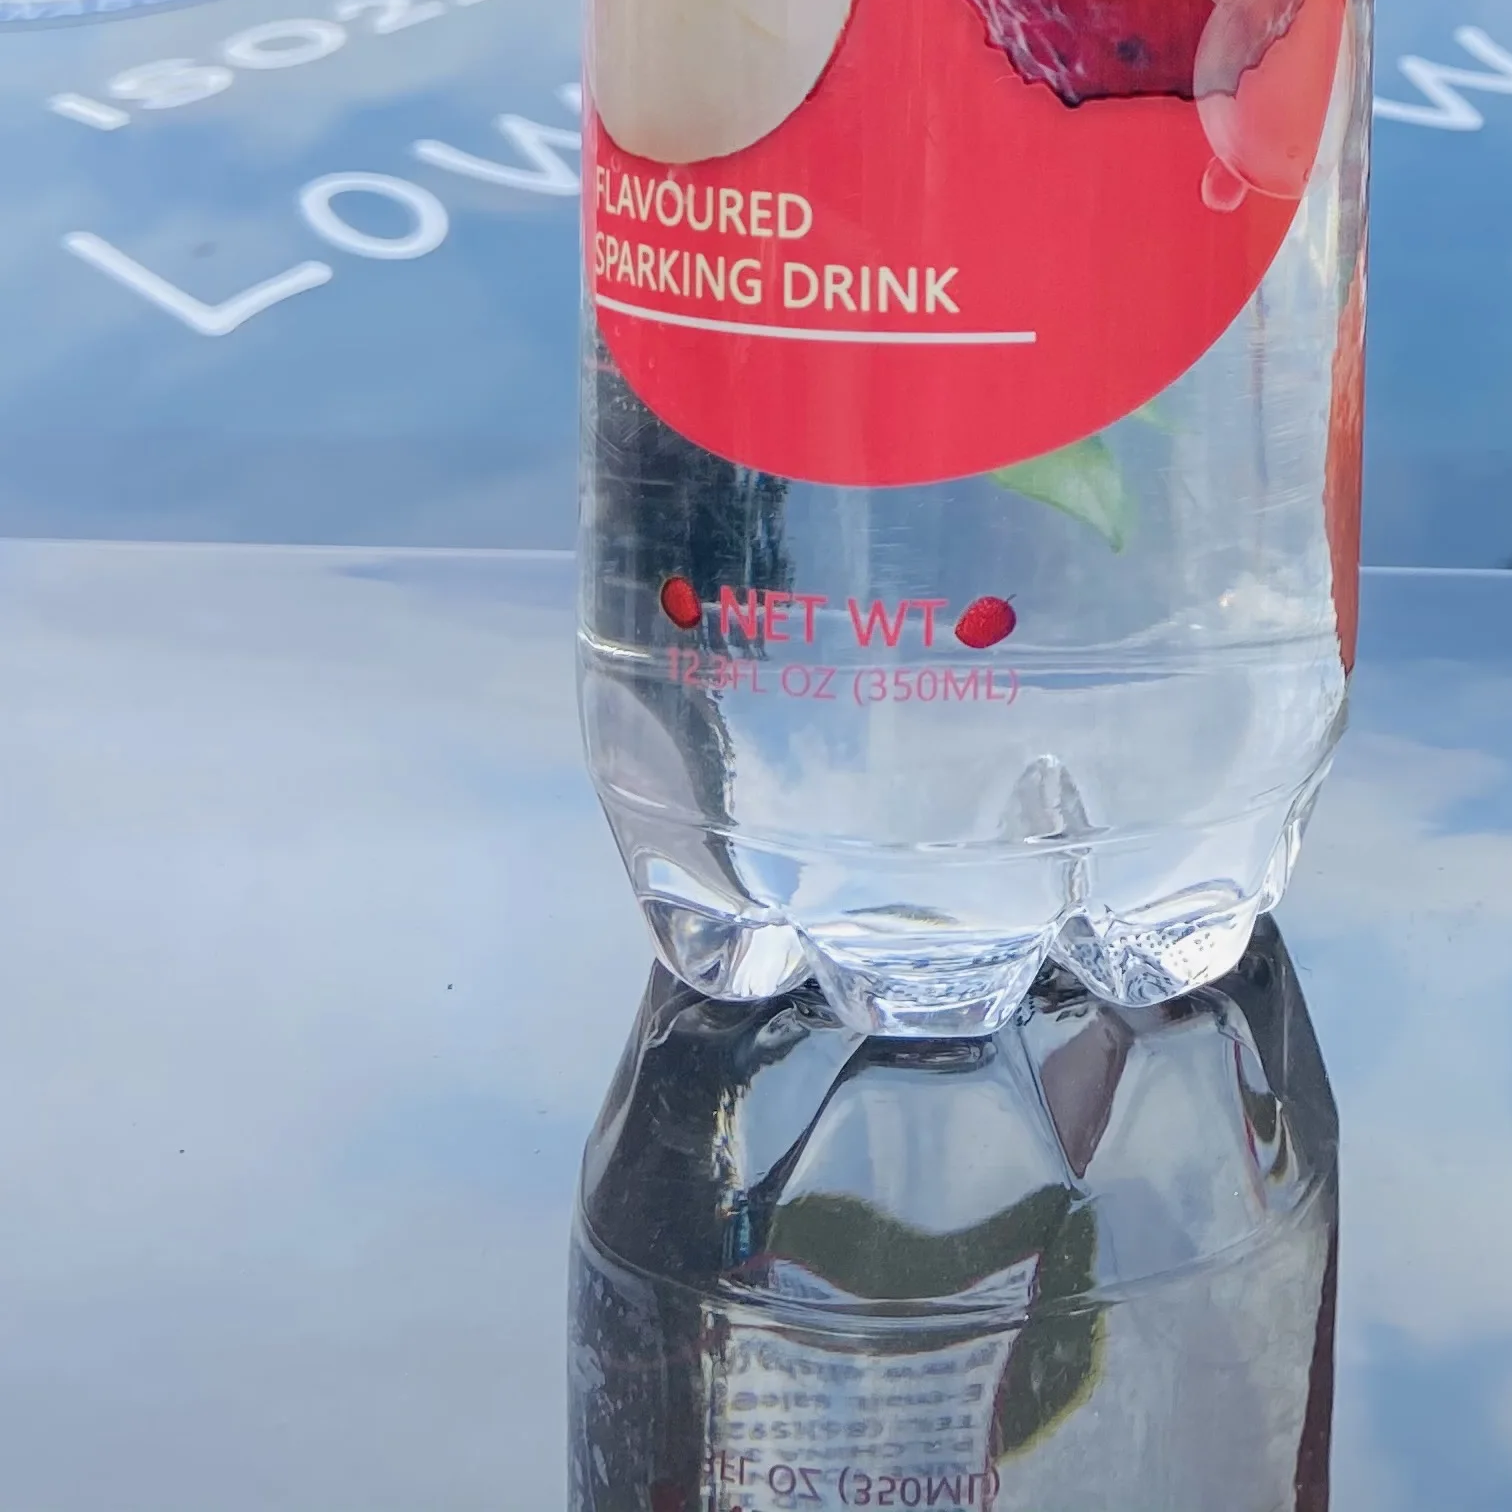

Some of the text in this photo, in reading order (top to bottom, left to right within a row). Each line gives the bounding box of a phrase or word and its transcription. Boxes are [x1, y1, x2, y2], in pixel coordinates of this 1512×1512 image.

[595, 164, 814, 240] FLAVOURED
[594, 230, 961, 315] SPARKING DRINK
[719, 585, 949, 648] NET WT
[781, 664, 838, 699] OZ
[853, 667, 1020, 706] (350ML)
